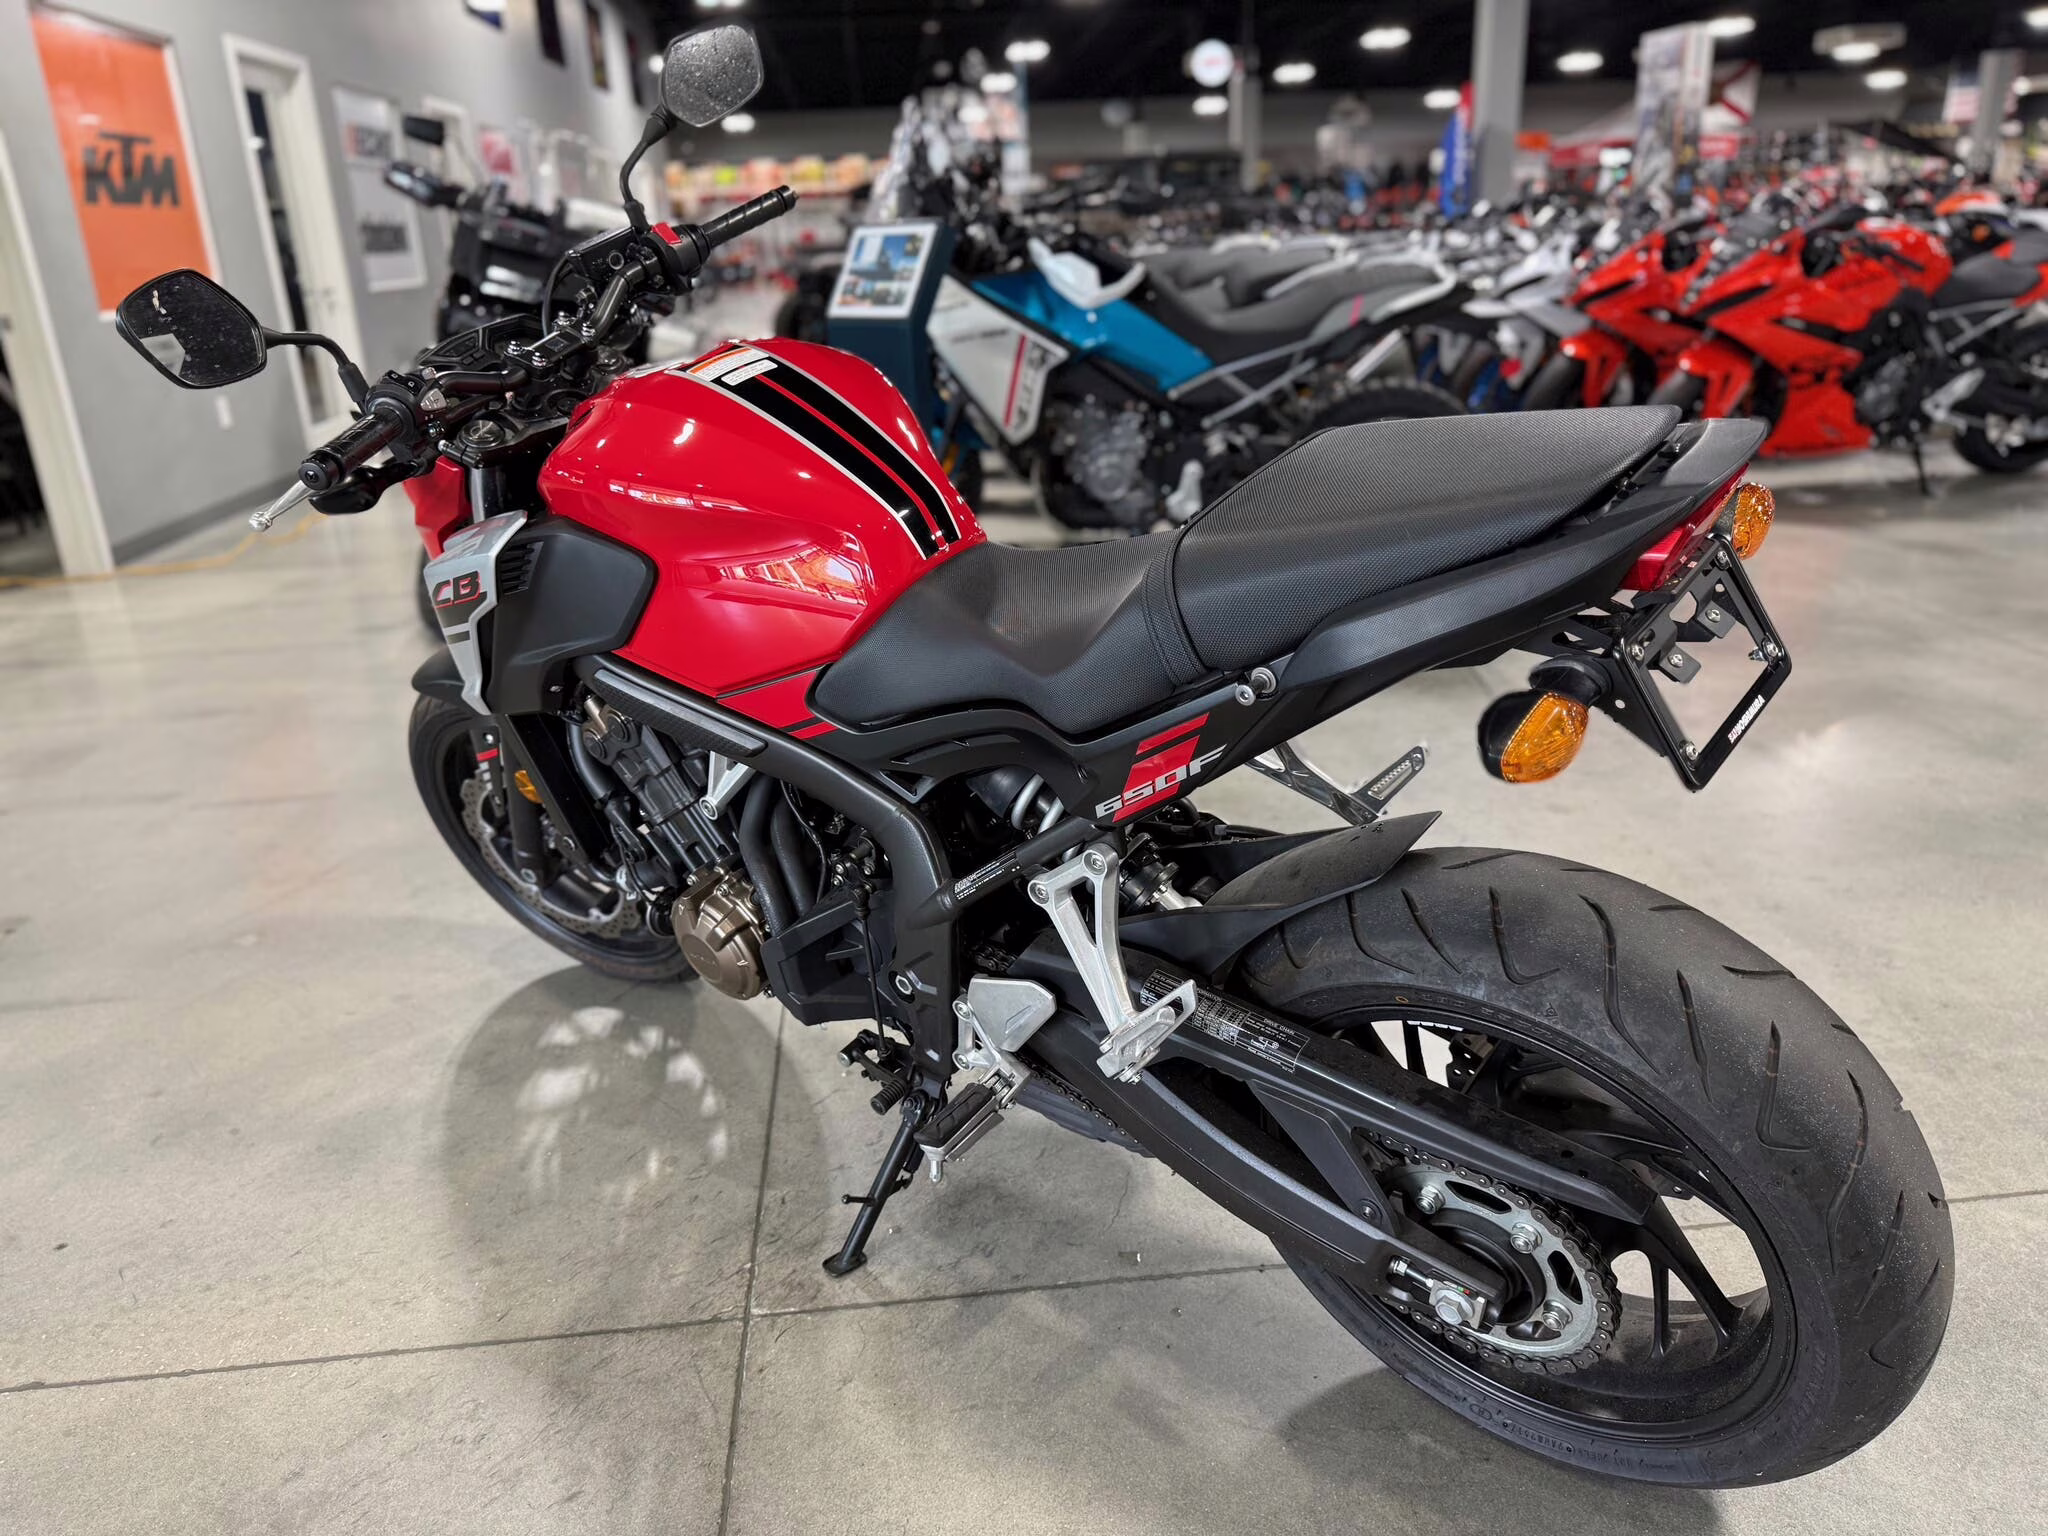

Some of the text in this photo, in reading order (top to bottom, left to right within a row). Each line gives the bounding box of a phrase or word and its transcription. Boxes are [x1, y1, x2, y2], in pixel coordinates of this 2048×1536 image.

[82, 131, 181, 207] KTM
[432, 570, 482, 608] CB
[1095, 744, 1228, 819] 650F
